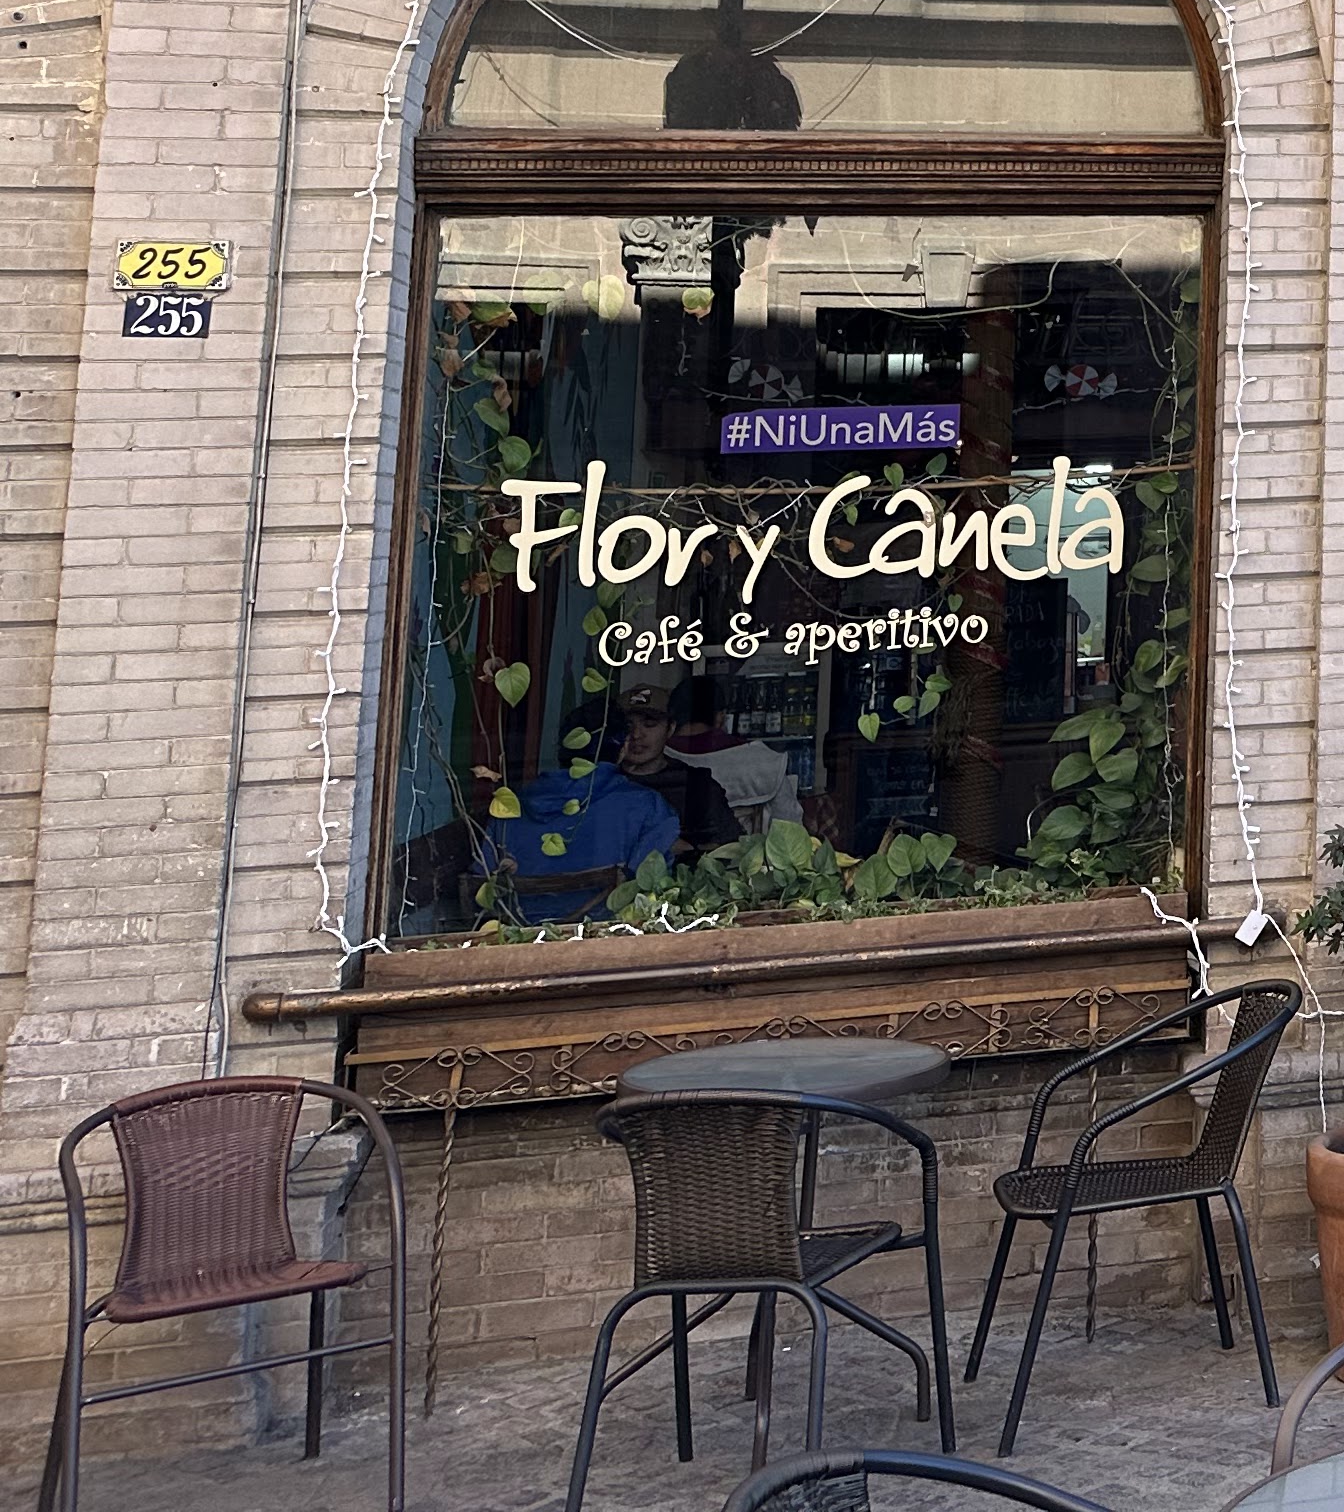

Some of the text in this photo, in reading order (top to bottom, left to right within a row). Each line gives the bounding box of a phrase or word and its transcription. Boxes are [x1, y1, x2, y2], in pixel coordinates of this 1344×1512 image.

[132, 247, 211, 279] 255
[130, 295, 204, 336] 255
[727, 409, 957, 449] #NiUnaMás
[501, 456, 1126, 604] Flor y Canela
[598, 616, 704, 667] Café
[723, 614, 769, 658] &
[783, 606, 990, 665] aperitivo
